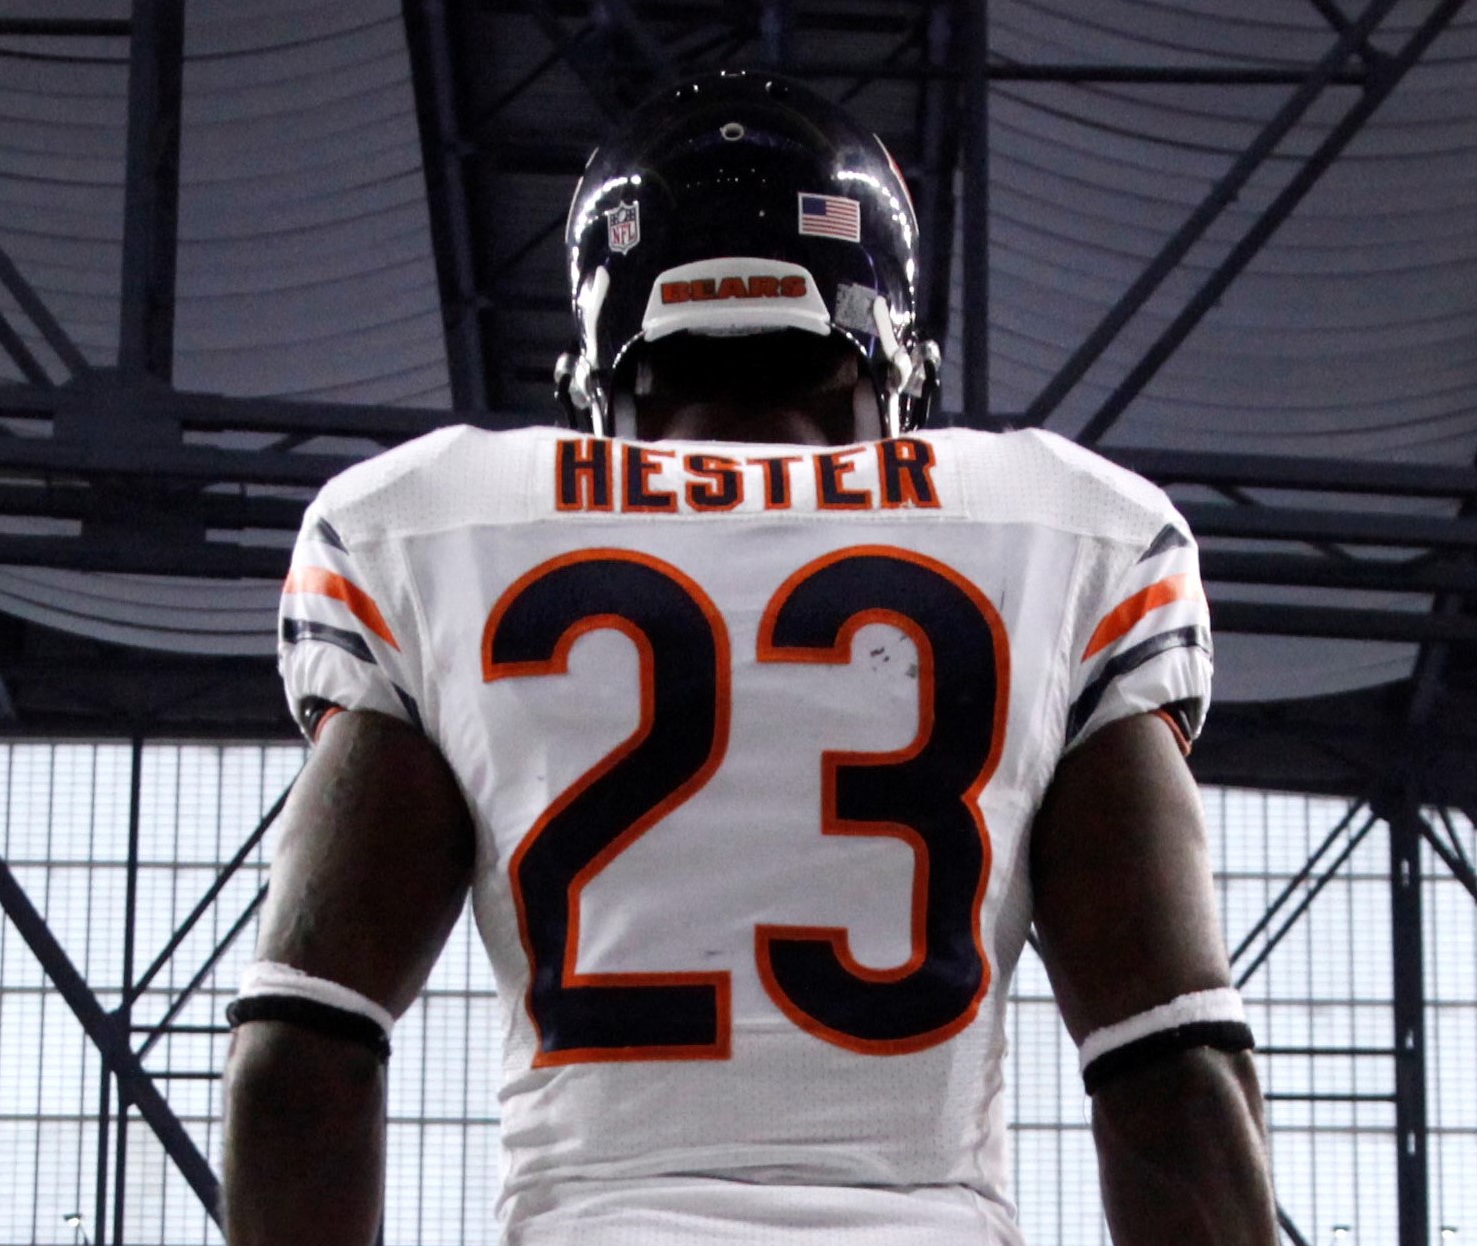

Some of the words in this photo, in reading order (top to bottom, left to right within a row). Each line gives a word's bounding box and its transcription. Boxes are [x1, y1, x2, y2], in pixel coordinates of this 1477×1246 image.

[660, 276, 807, 305] BEARS
[554, 437, 942, 514] HESTER
[481, 544, 1011, 1069] 23
